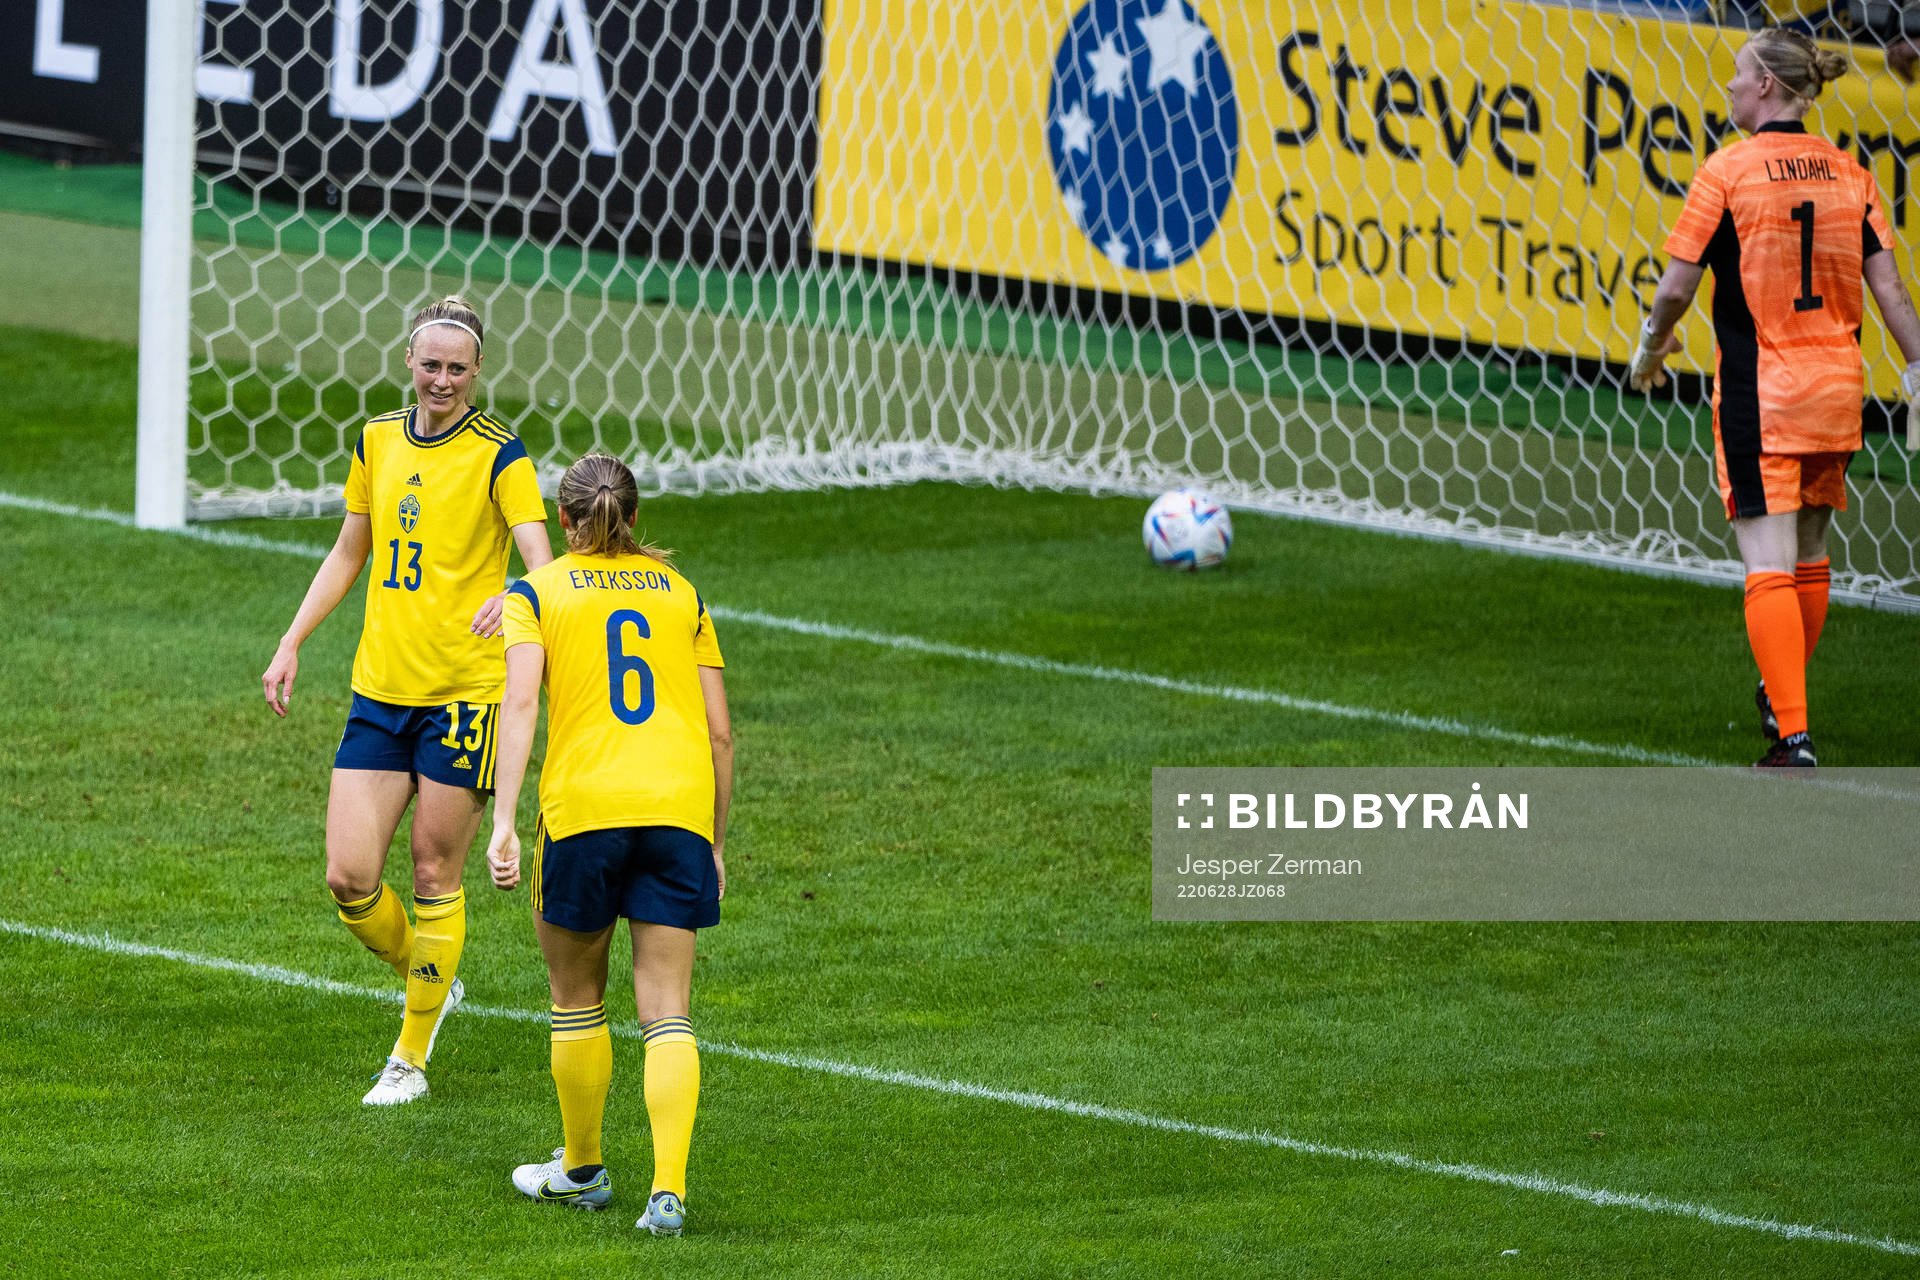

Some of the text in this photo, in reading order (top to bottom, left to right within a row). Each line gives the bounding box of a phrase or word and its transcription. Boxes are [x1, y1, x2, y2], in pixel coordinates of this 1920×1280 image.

[1276, 30, 1541, 178] Steve
[1765, 158, 1837, 182] LINDAHL
[1274, 190, 1456, 294] Sport
[1791, 201, 1823, 312] 1
[383, 538, 423, 592] 13
[569, 570, 671, 593] ERIKSSON
[606, 609, 655, 726] 6
[441, 702, 488, 752] 13
[410, 969, 444, 984] adidas
